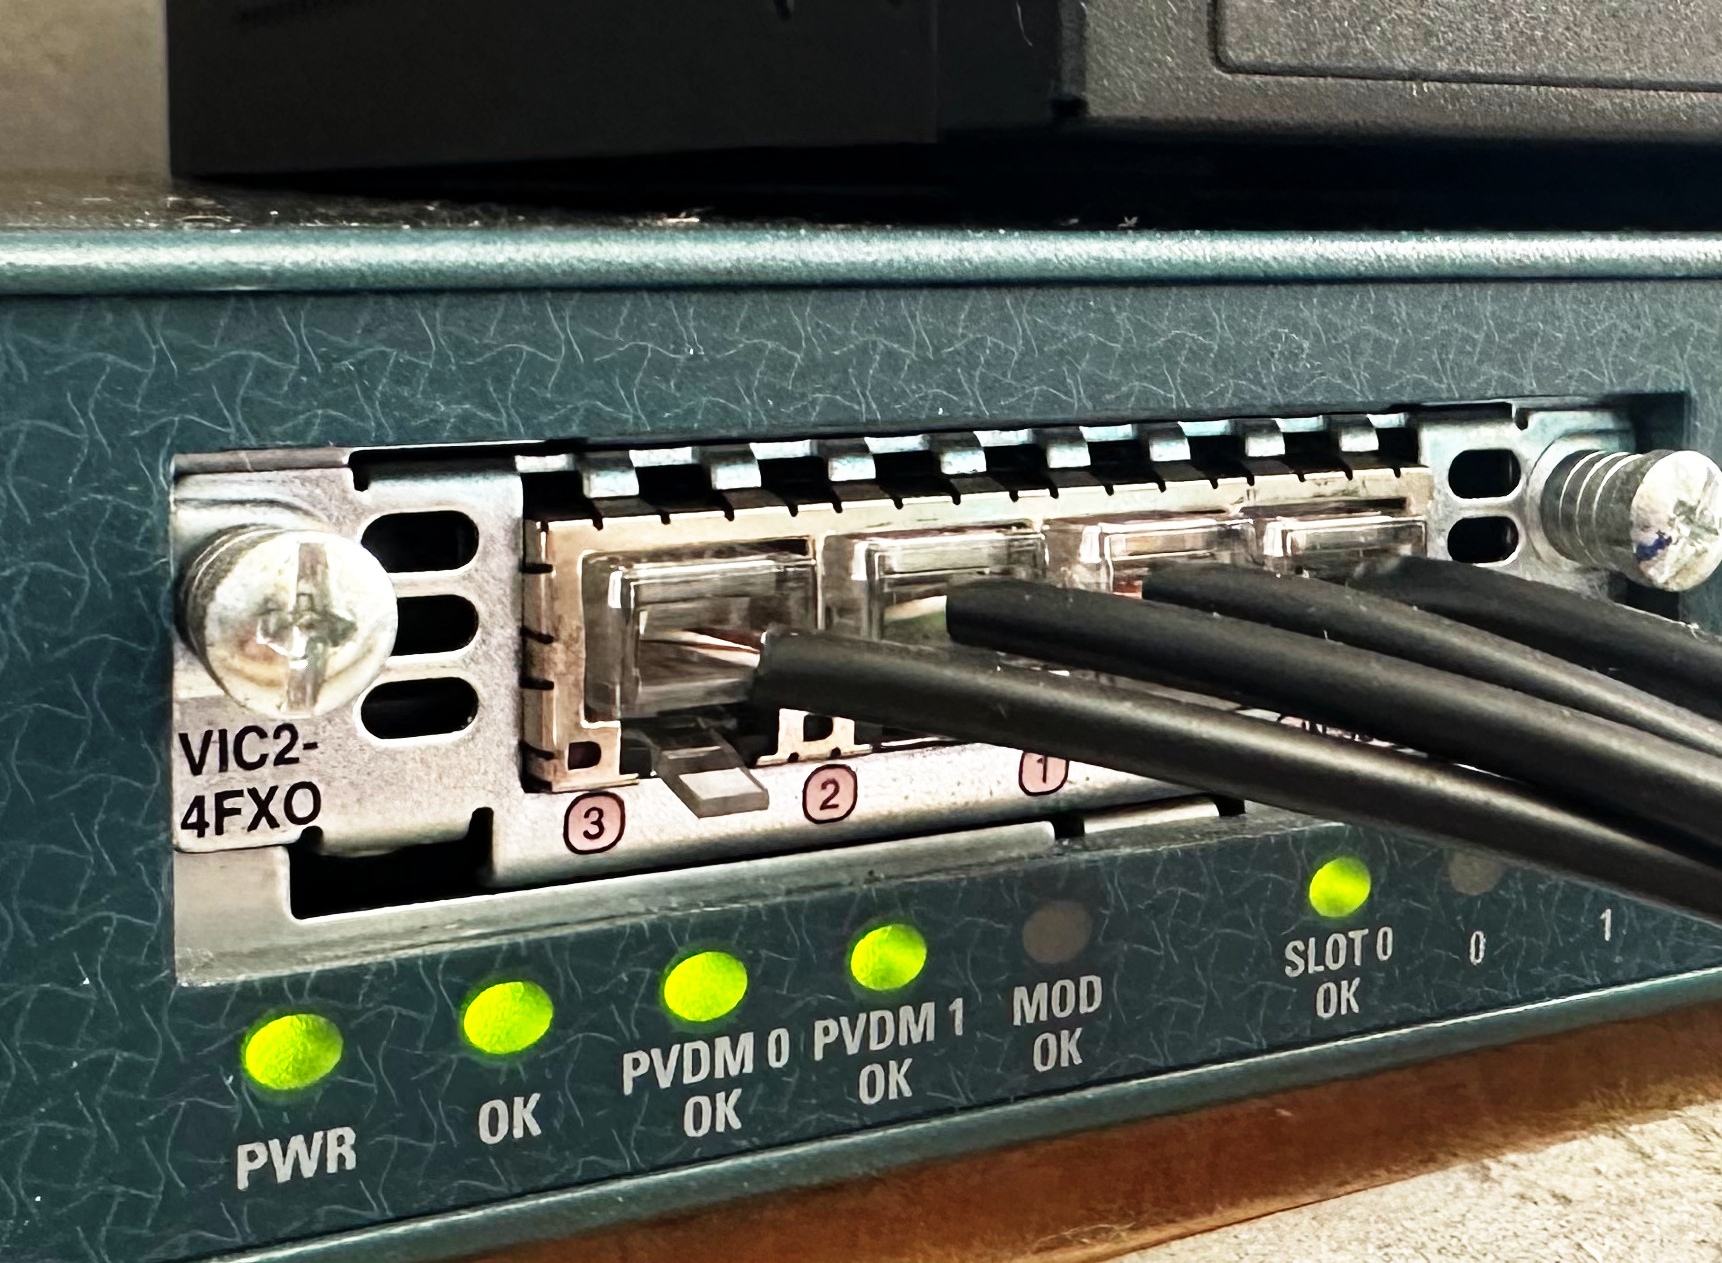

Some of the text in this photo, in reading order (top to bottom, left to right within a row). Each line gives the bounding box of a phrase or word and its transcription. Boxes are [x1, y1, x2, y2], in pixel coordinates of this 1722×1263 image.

[178, 722, 321, 777] VIC2-
[179, 779, 323, 840] 4FXO
[1284, 925, 1394, 979] SLOT 0
[1469, 930, 1487, 966] 0
[1599, 908, 1612, 942] 1
[1012, 974, 1103, 1028] MOD
[1316, 976, 1361, 1021] OK
[813, 996, 965, 1061] PVDM 1
[1032, 1026, 1084, 1074] OK
[622, 1027, 791, 1096] PVDM 0
[857, 1055, 913, 1106] OK
[476, 1091, 543, 1145] OK
[683, 1087, 743, 1139] OK
[236, 1125, 359, 1191] PWR
